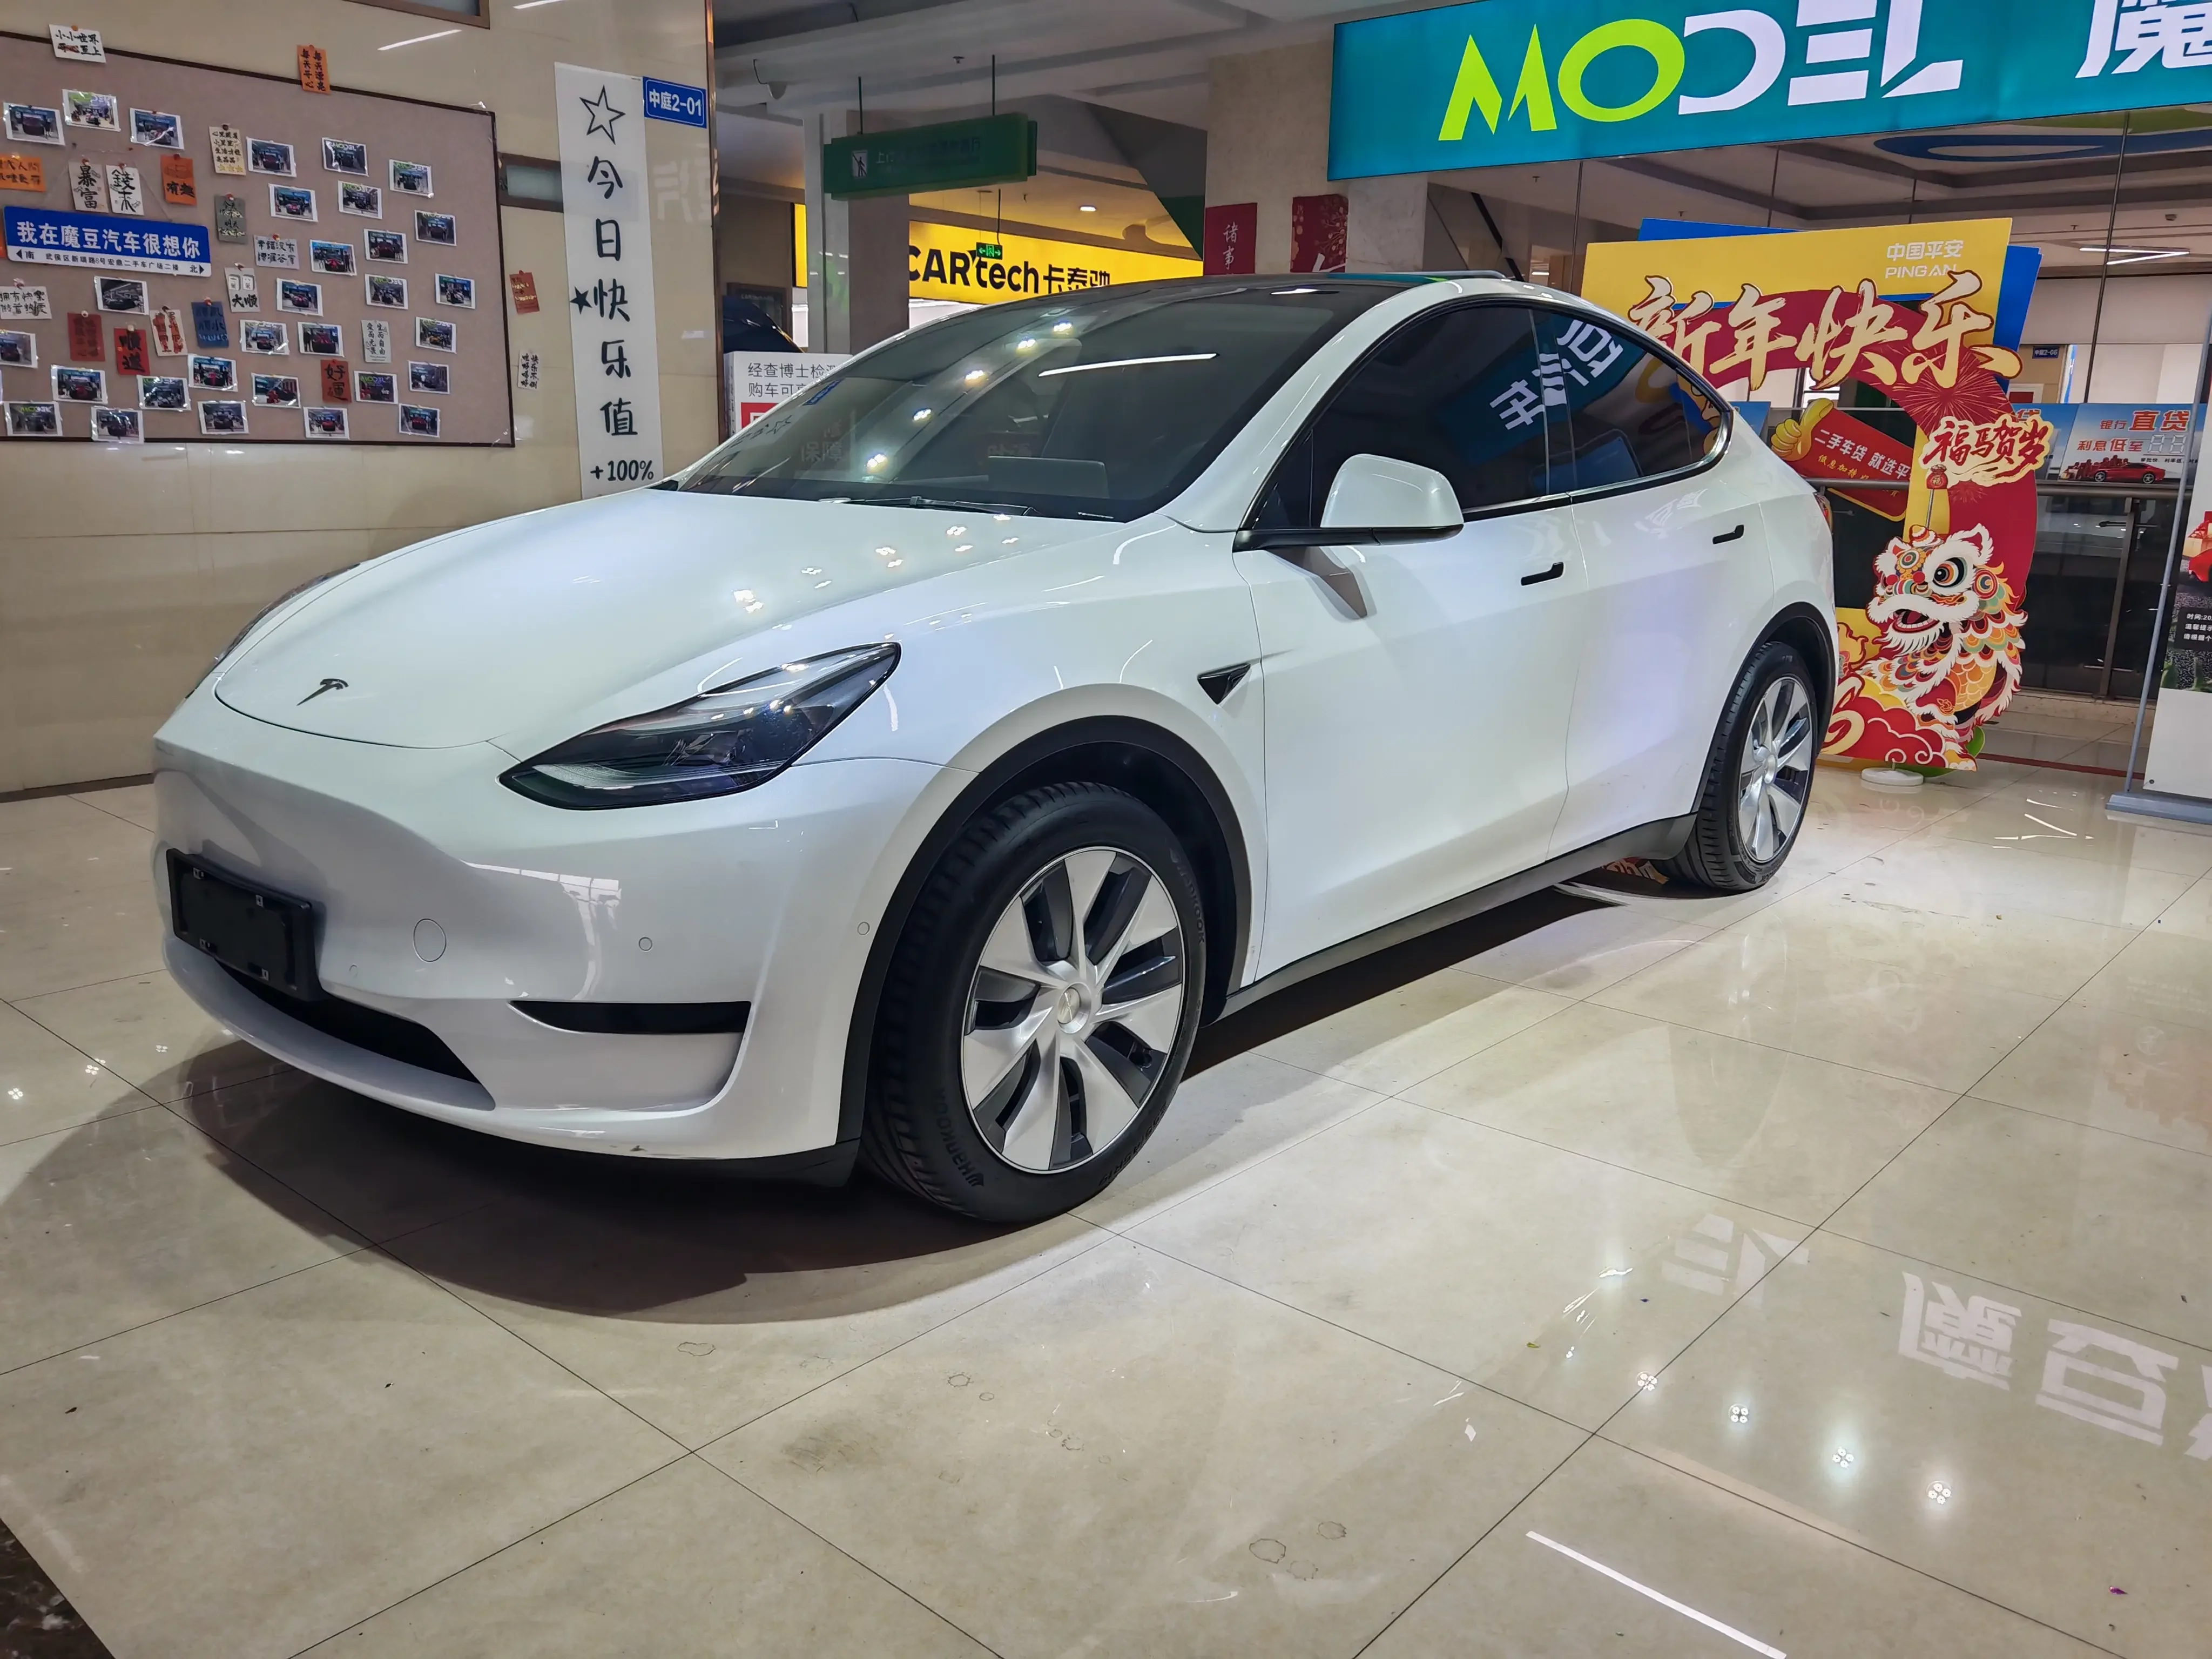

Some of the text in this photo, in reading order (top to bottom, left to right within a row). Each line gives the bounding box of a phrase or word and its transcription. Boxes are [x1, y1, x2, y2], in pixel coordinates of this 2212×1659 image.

[1438, 0, 1963, 142] MODEL
[649, 89, 703, 117] 中庭2-01
[78, 165, 98, 210] 暴富
[17, 221, 201, 259] 我在魔豆汽车很想你
[1223, 221, 1239, 274] 诸事
[1886, 239, 1964, 261] 中国平安
[25, 251, 35, 260] 南
[190, 265, 198, 273] 北
[1885, 265, 1927, 279] PING
[588, 156, 638, 436] 今日快乐值
[1628, 270, 2023, 392] 新年快乐
[2100, 409, 2190, 432] 银行 直贷
[1923, 419, 2049, 468] 福马贺岁
[2077, 437, 2144, 452] 利息低至
[590, 459, 655, 482] +100%
[1867, 451, 1911, 480] 就选平
[2187, 613, 2212, 621] 时间:20
